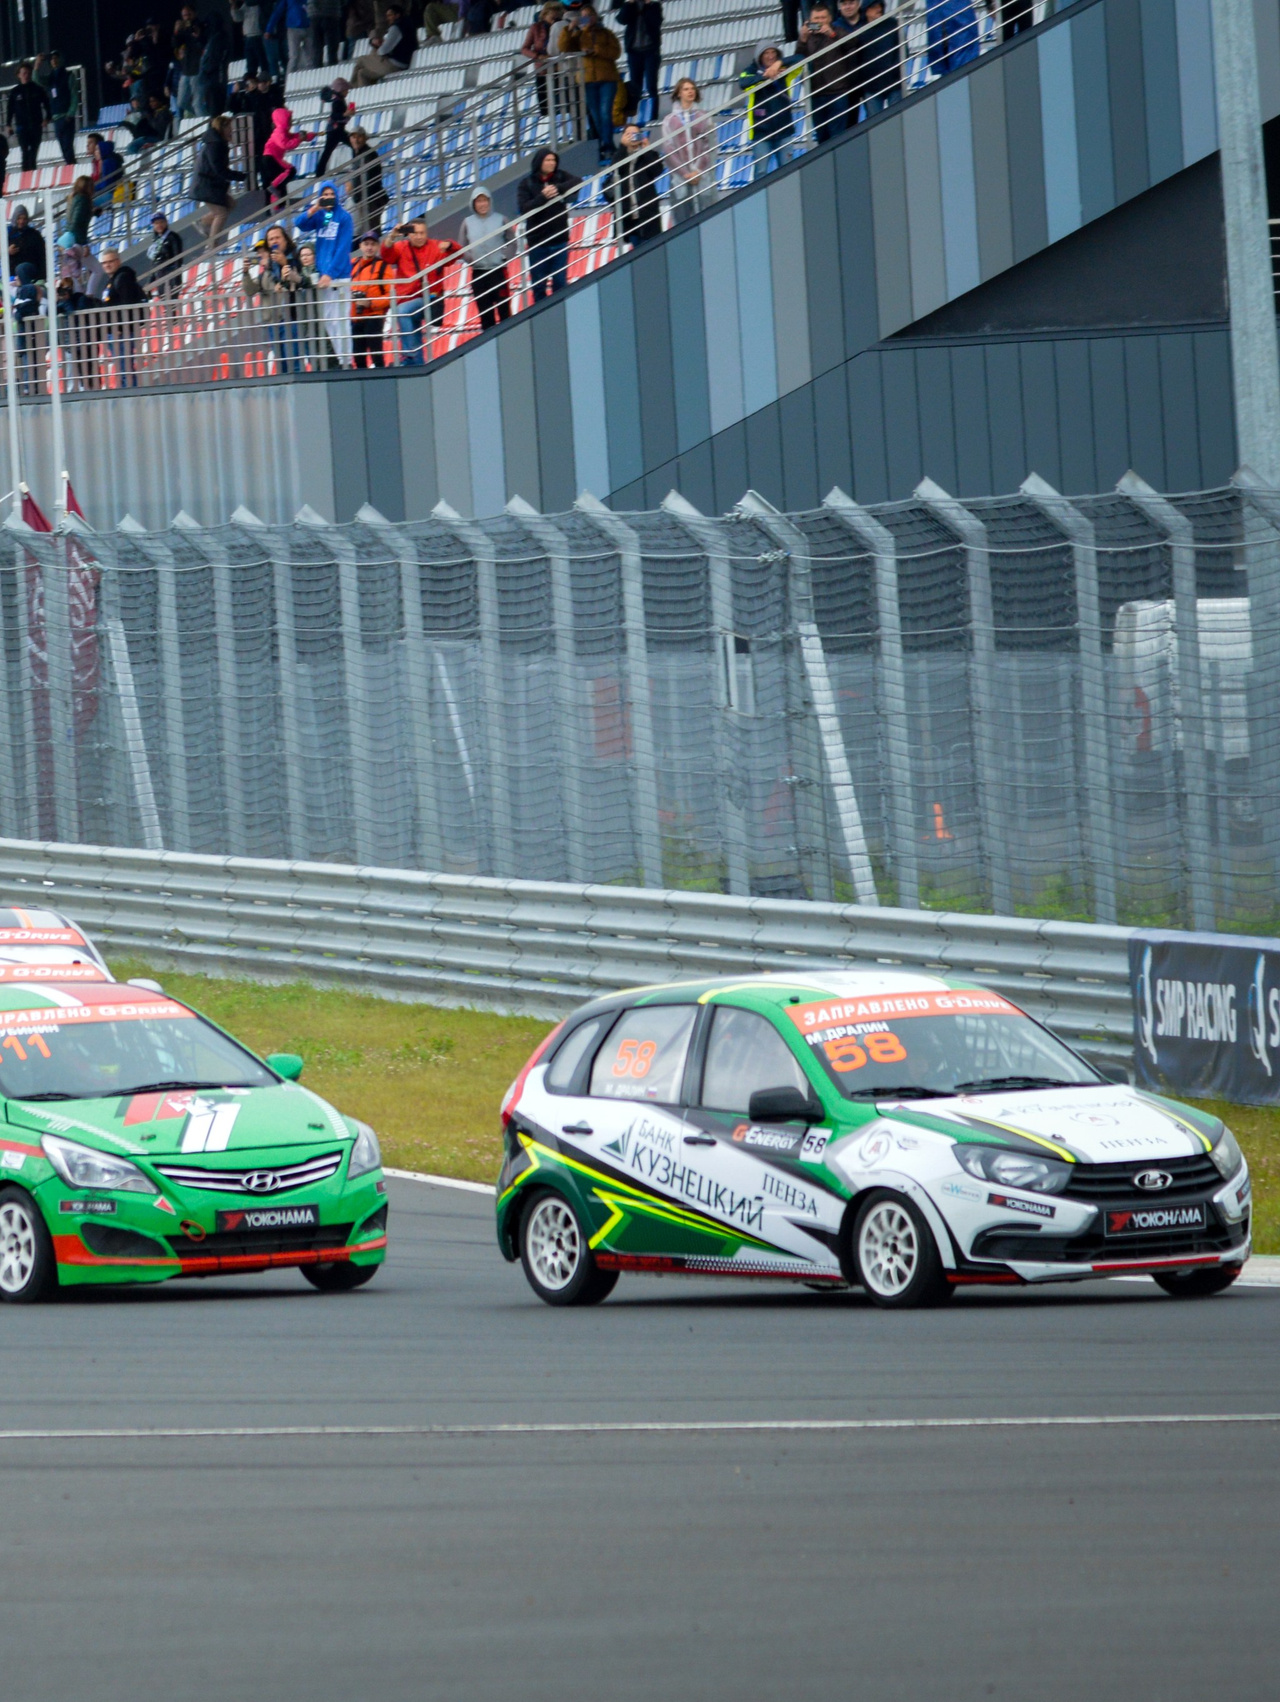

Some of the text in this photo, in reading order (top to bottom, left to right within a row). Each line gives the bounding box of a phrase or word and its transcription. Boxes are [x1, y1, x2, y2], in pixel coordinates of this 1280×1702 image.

[804, 998, 930, 1026] ЗАПРАВЛЕНО
[1186, 981, 1238, 1043] RACING
[612, 1039, 657, 1078] 58
[822, 1031, 907, 1073] 58
[637, 1119, 676, 1152] БАНК
[802, 1135, 827, 1154] 58
[631, 1142, 765, 1232] КУЗНЕЦКИЙ
[762, 1173, 819, 1217] ПЕНЗА
[244, 1207, 314, 1227] YOKOHAMA
[1005, 1199, 1051, 1216] YOKOHAMA
[1132, 1207, 1202, 1229] YOKOHAMA
